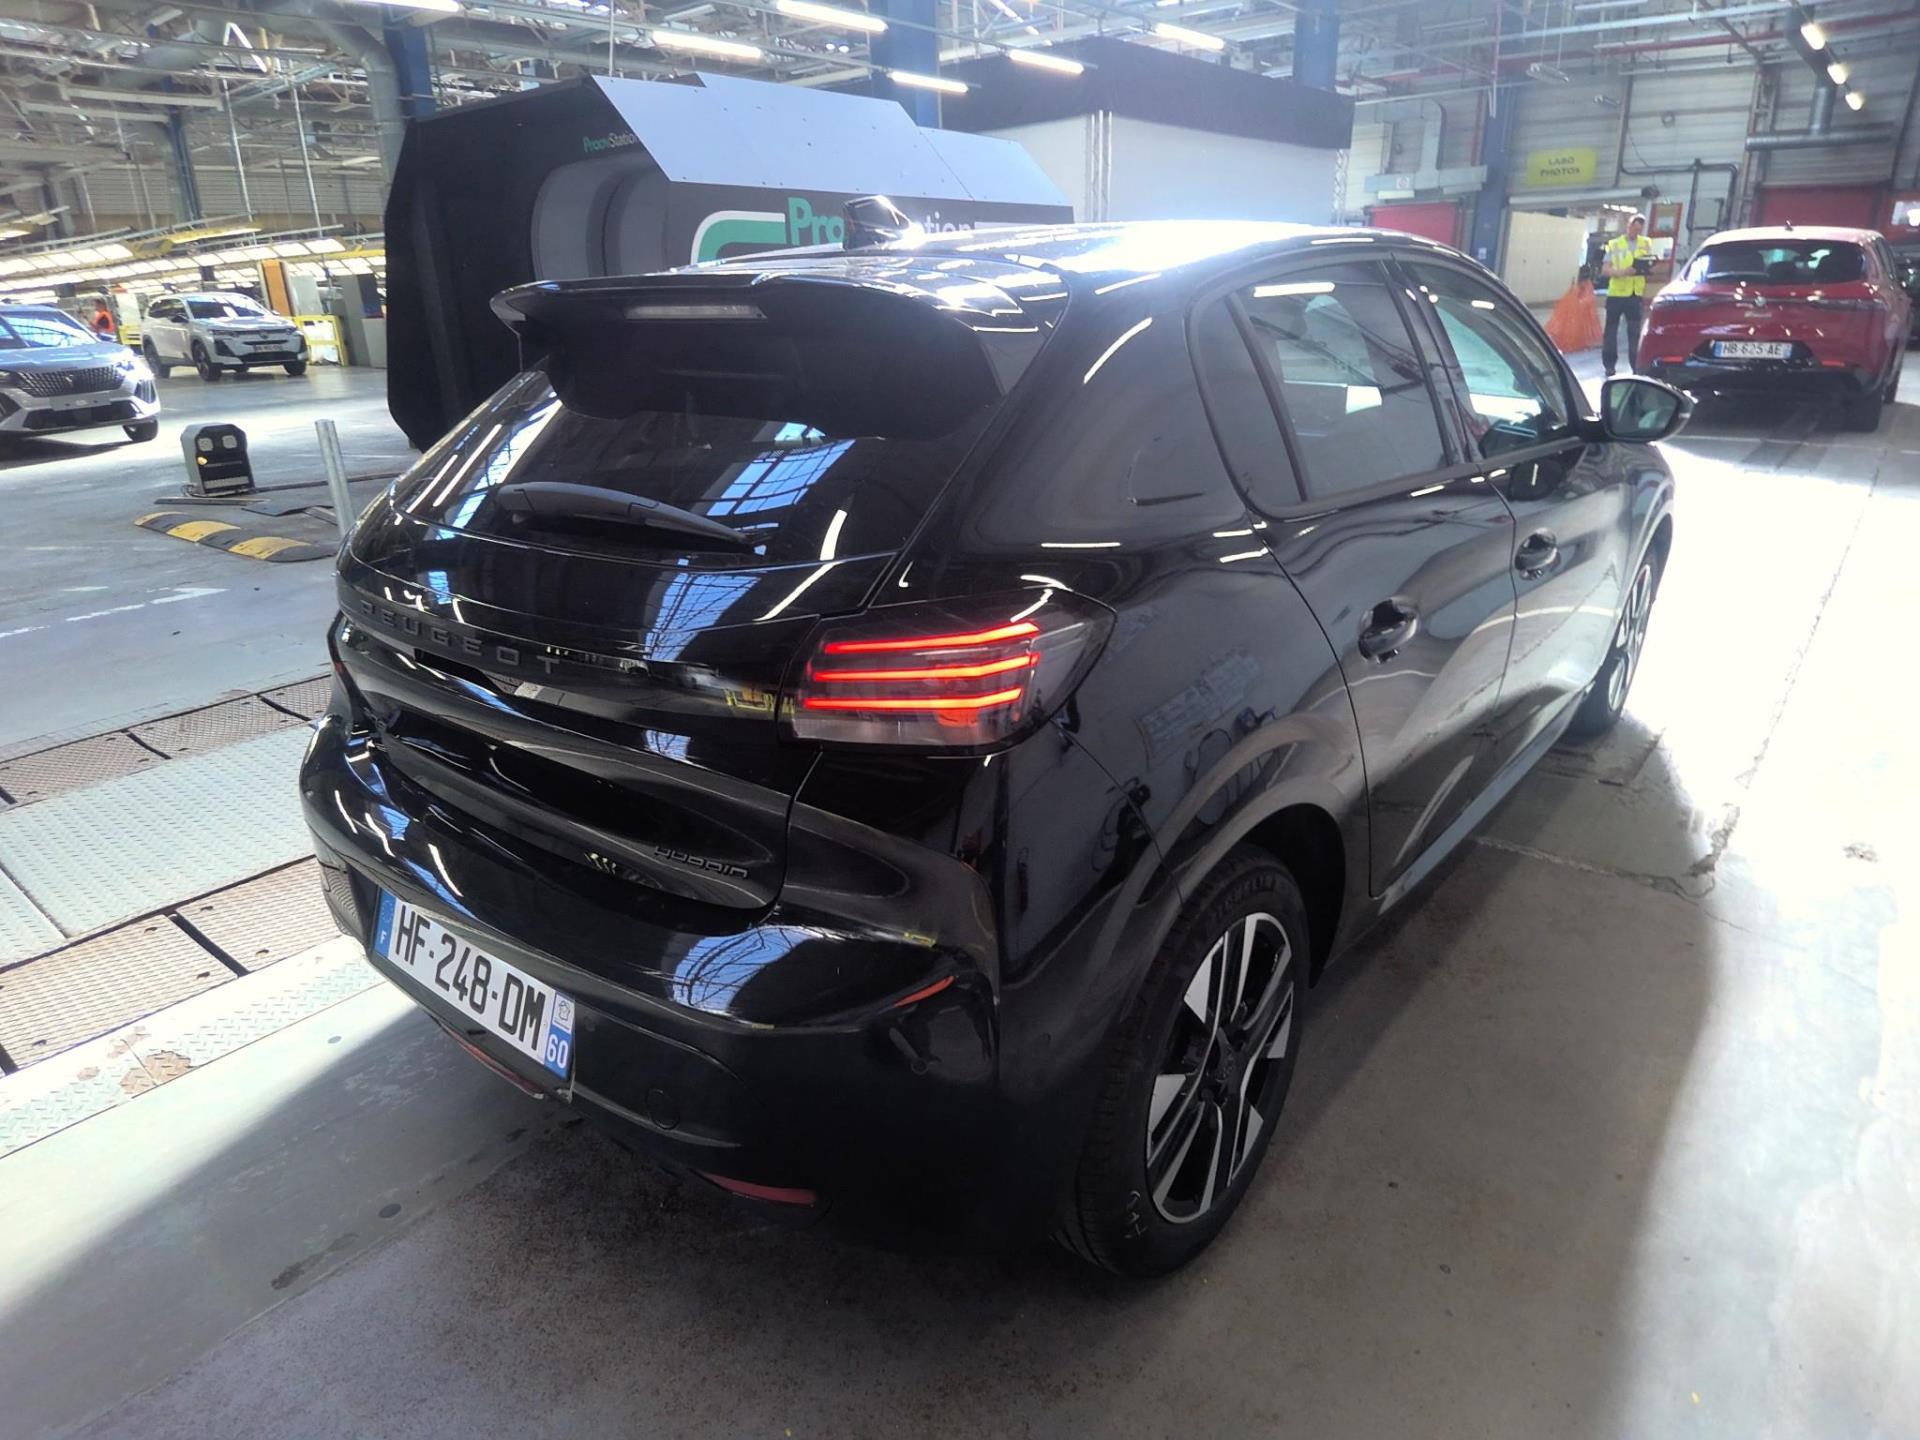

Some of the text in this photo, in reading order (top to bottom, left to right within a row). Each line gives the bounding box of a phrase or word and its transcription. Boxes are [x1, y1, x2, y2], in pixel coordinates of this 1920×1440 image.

[1548, 156, 1575, 166] LABO
[360, 600, 560, 675] PEUGEOT
[379, 905, 569, 1069] F HF-248-DM 60
